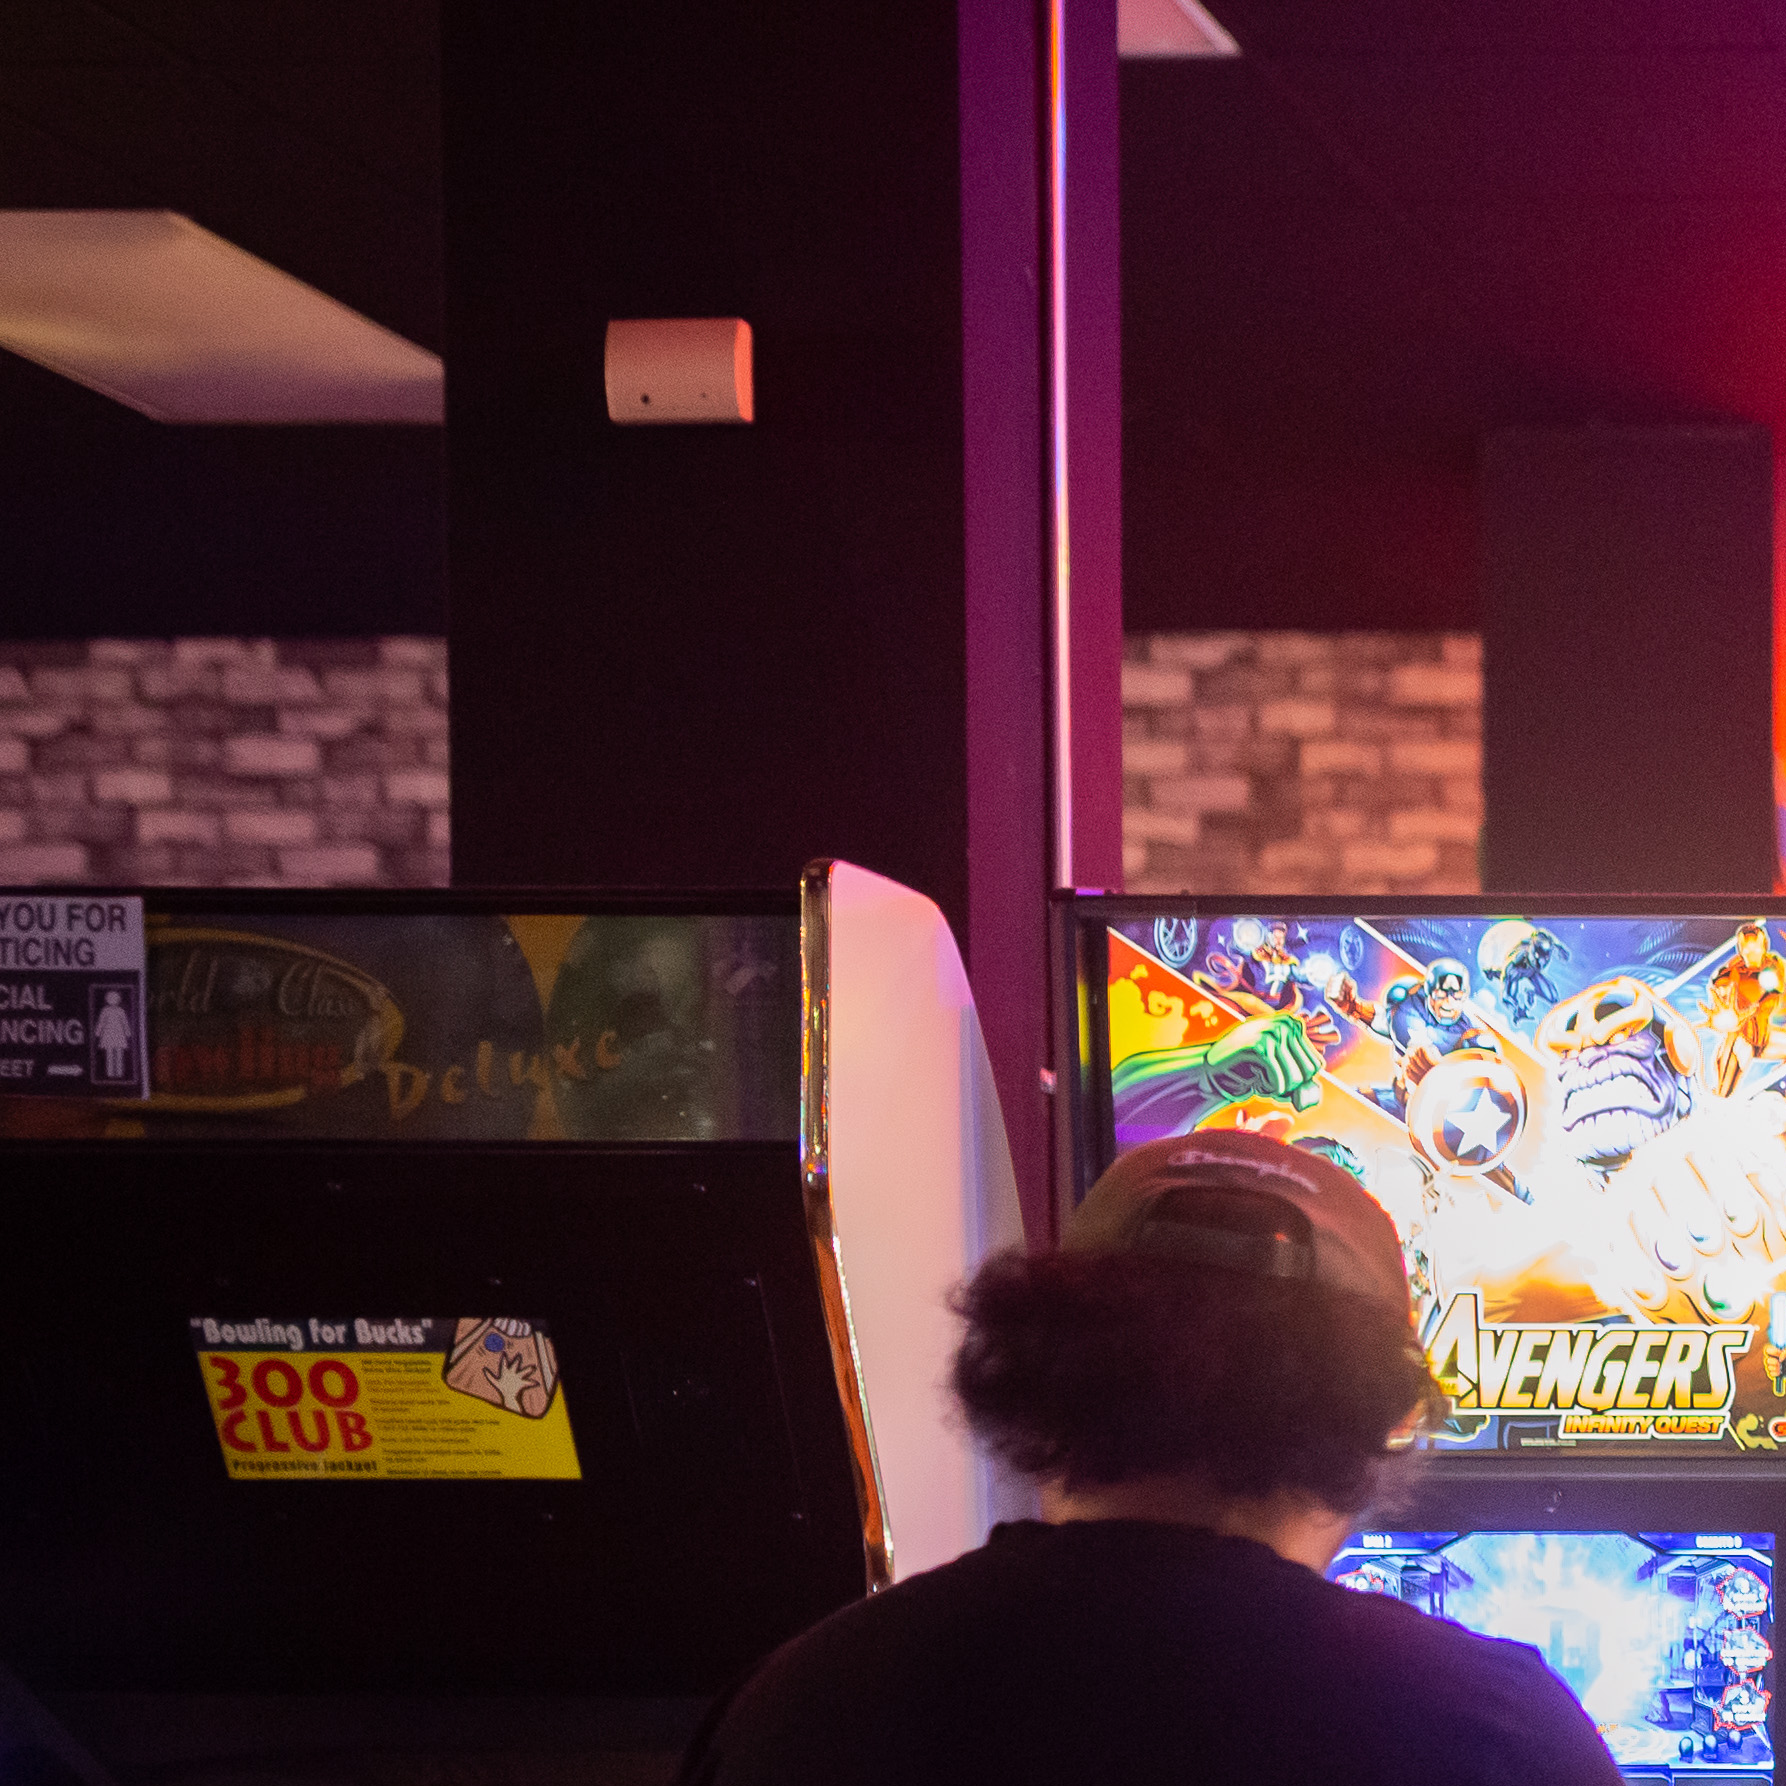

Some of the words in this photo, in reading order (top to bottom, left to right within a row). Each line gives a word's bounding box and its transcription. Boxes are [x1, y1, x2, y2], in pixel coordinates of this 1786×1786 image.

[0, 902, 55, 932] YOU
[66, 902, 127, 932] FOR
[385, 1029, 622, 1121] Deluxe
[309, 1318, 348, 1345] for
[1428, 1291, 1749, 1413] AVENGERS
[209, 1356, 360, 1411] 300
[219, 1409, 373, 1454] CLUB
[1563, 1415, 1654, 1434] INFINITY
[1656, 1414, 1726, 1434] QUEST
